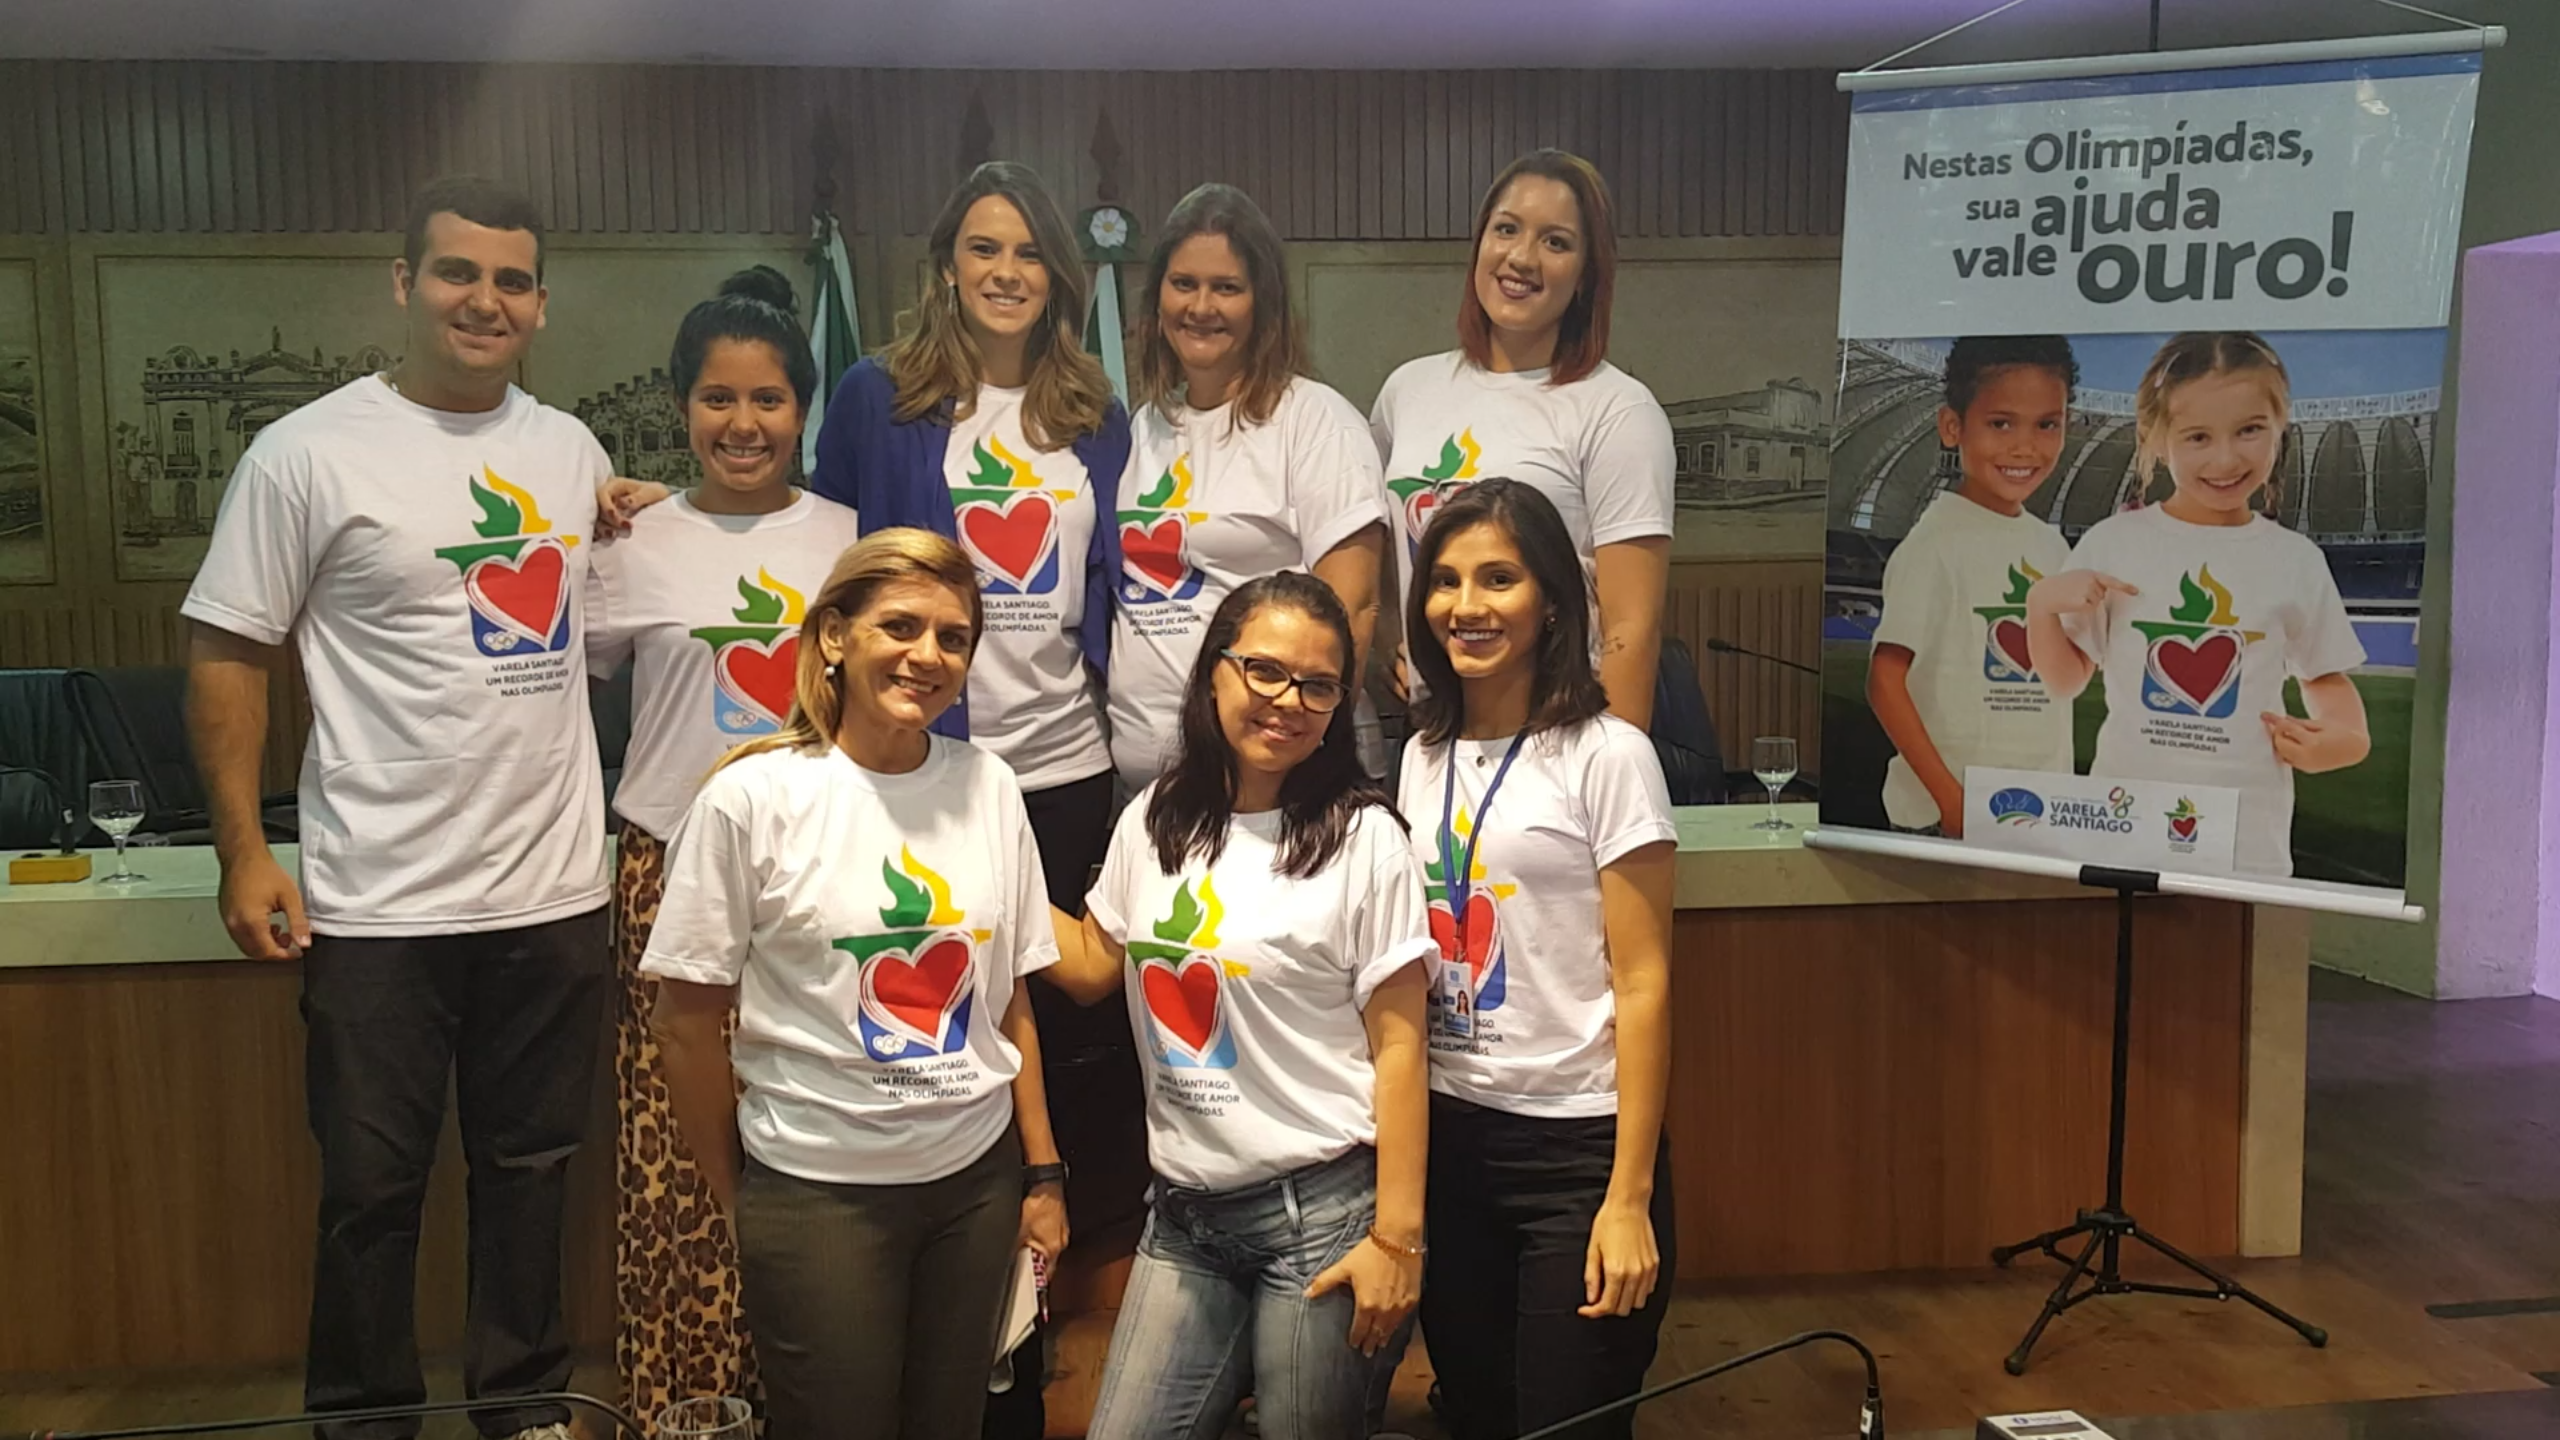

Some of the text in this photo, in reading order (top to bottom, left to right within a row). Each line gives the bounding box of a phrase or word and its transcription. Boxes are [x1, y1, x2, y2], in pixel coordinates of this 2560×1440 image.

[1904, 120, 2313, 180] Nestas Olimpíadas,
[1966, 172, 2220, 253] sua ajuda
[1953, 211, 2354, 304] vale ouro!
[492, 661, 530, 673] VARELA
[485, 678, 502, 686] UM
[503, 673, 544, 685] RECORDE
[501, 686, 520, 697] NAS
[2050, 801, 2108, 818] VARELA
[2049, 814, 2133, 834] SANTIAGO
[872, 1075, 890, 1085] UM
[1194, 1093, 1206, 1103] DE
[1209, 1093, 1240, 1103] AMOR
